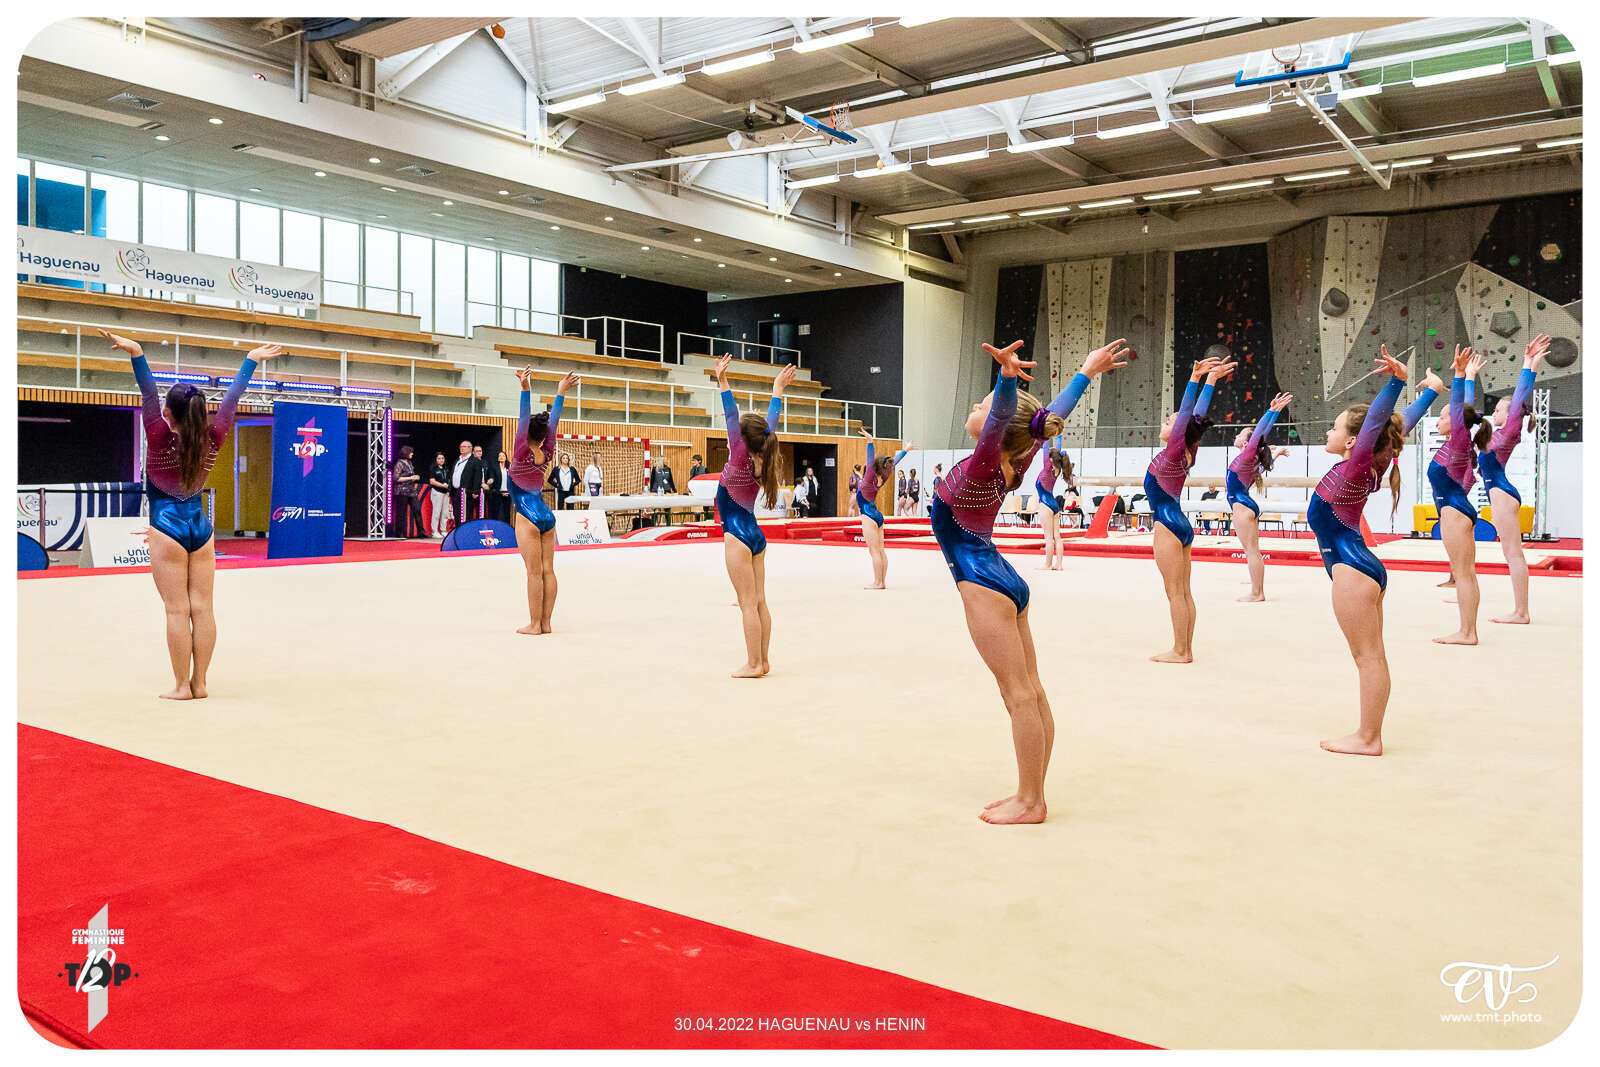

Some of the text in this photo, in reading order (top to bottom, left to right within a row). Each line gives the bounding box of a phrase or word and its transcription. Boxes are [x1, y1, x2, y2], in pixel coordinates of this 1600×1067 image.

[20, 251, 100, 272] Haguenau
[145, 268, 215, 288] Haguenau
[254, 284, 314, 301] Haguenau
[293, 443, 325, 456] TOP
